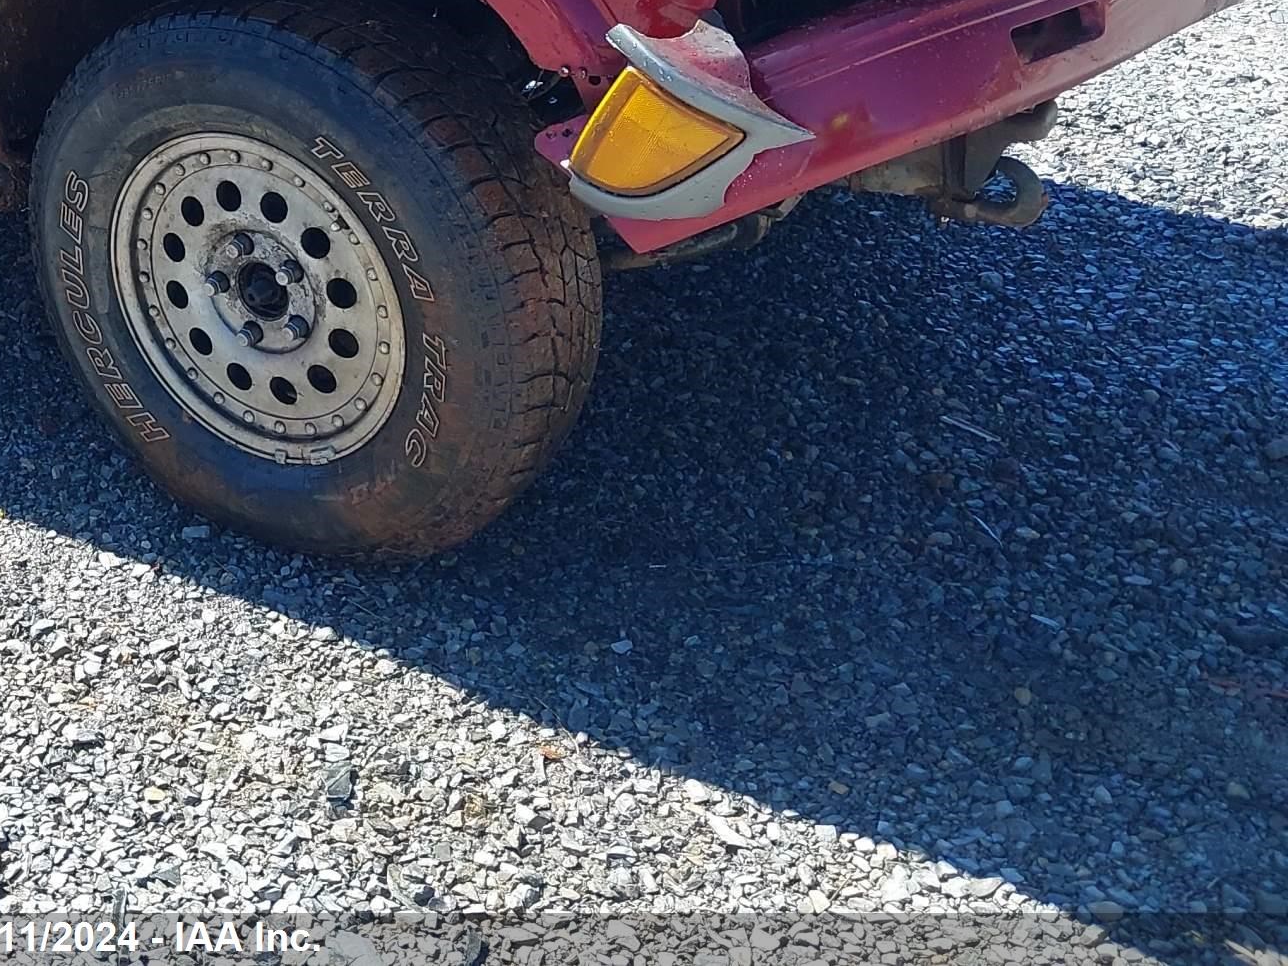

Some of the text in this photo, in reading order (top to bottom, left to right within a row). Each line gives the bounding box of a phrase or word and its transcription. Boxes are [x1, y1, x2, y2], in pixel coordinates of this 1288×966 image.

[60, 170, 171, 443] HERCULES
[311, 136, 446, 468] TERRA TRAC
